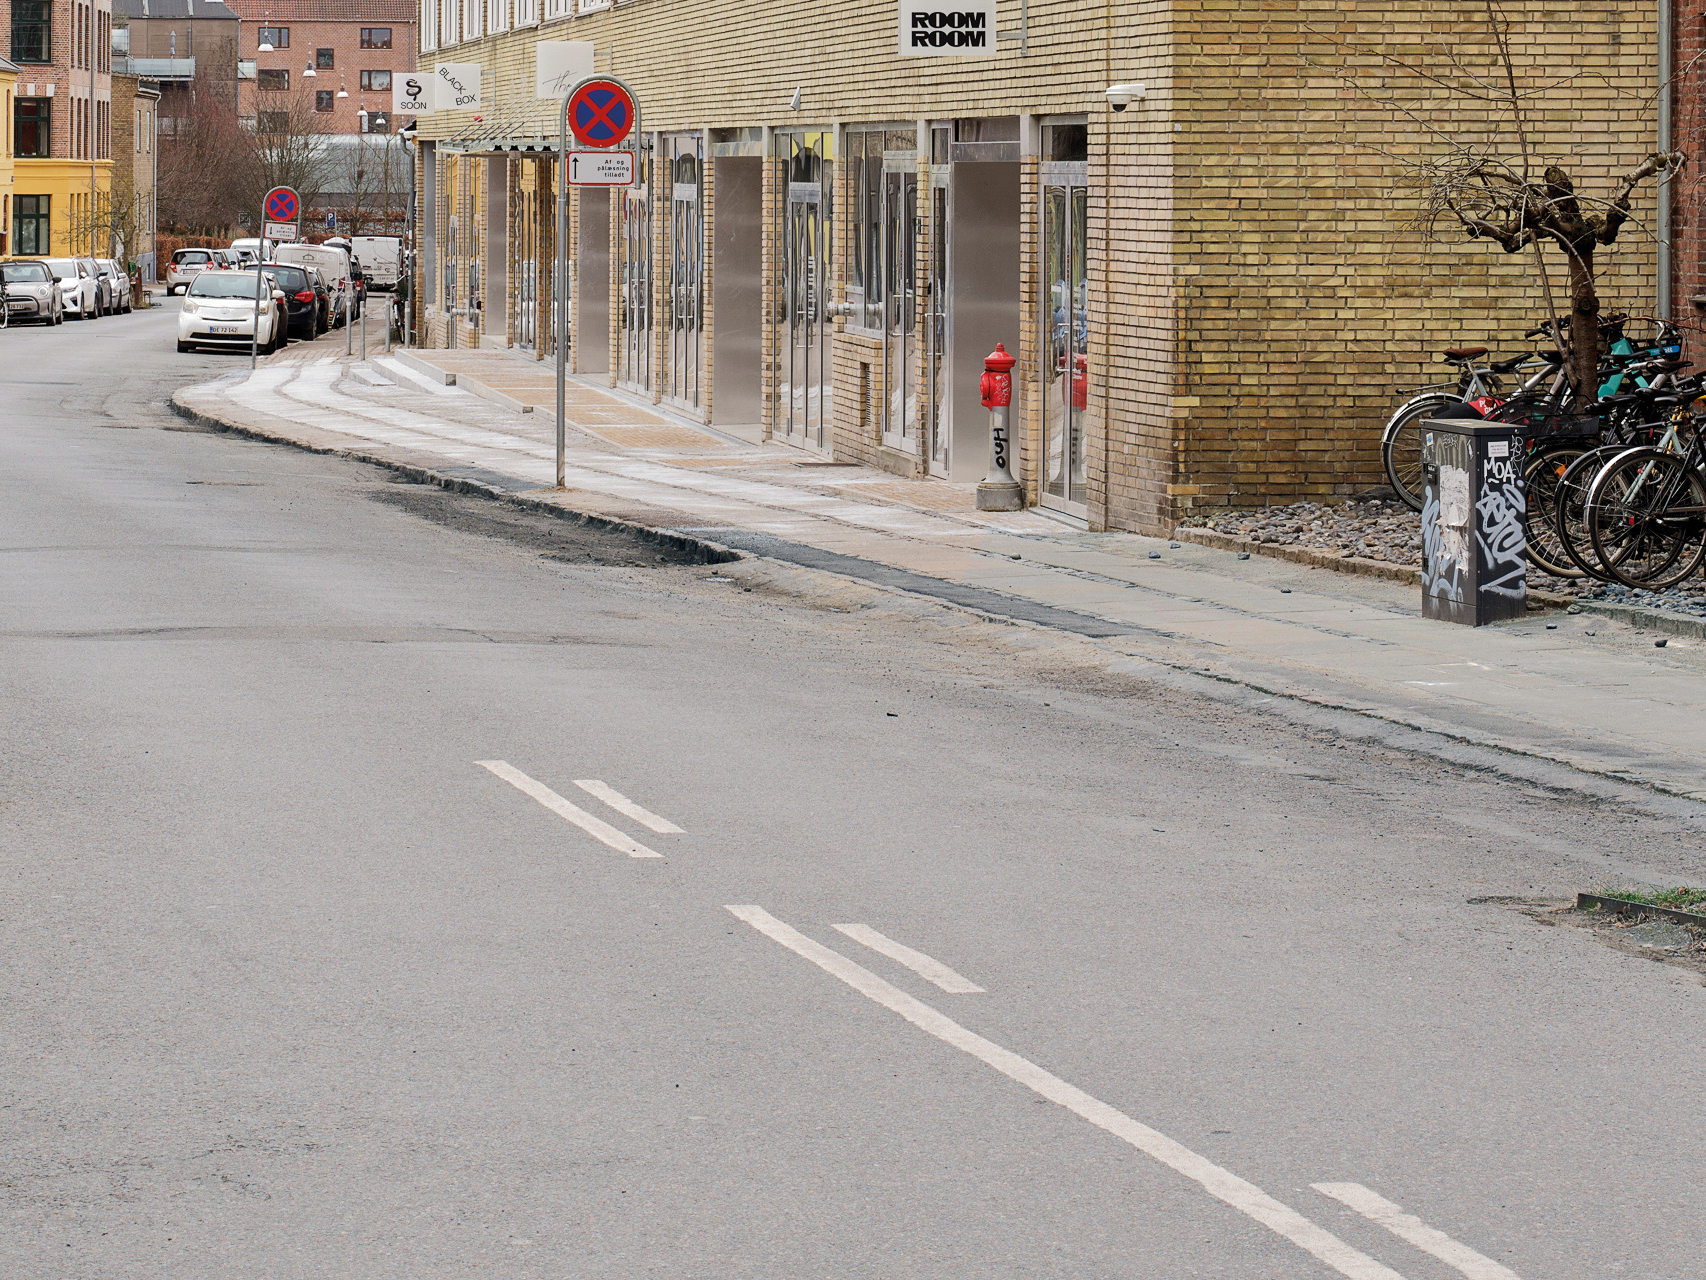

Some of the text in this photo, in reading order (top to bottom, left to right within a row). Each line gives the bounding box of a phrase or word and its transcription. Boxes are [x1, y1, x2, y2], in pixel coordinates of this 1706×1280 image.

[911, 11, 986, 29] ROOM
[911, 30, 986, 48] ROOM
[438, 67, 467, 95] BLACK
[400, 101, 427, 110] SOON
[455, 93, 477, 106] BOX
[327, 212, 334, 220] P
